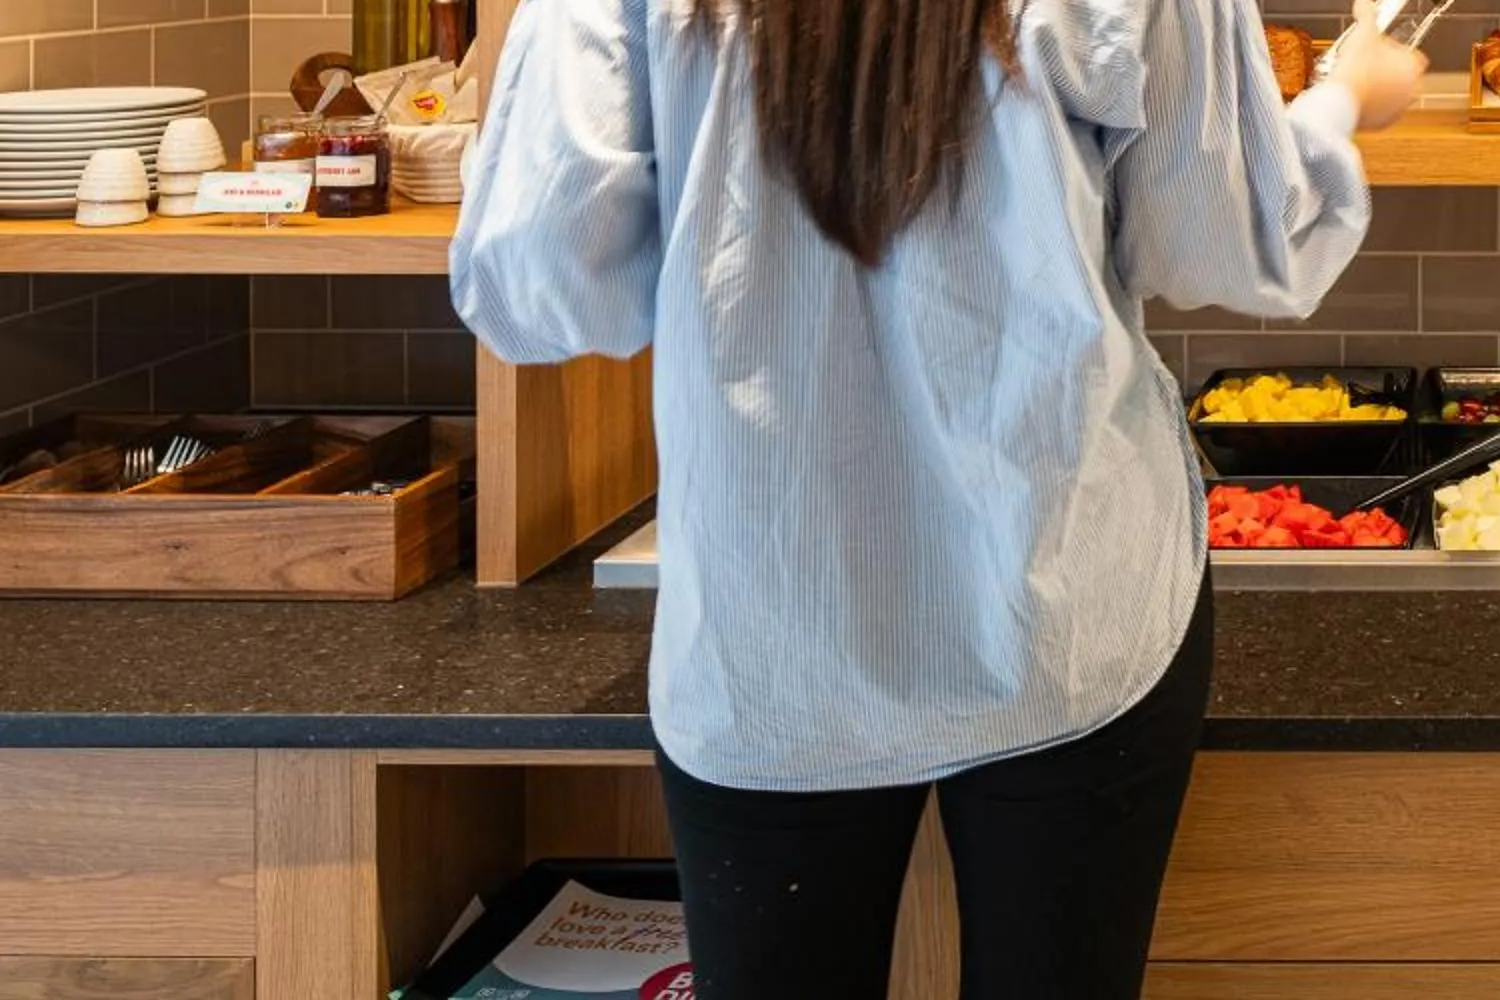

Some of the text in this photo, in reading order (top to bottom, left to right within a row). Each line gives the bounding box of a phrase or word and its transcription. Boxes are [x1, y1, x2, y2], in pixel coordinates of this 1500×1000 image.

[568, 900, 627, 922] Who
[548, 917, 606, 936] love
[610, 926, 626, 936] a
[534, 931, 679, 954] breakfast?
